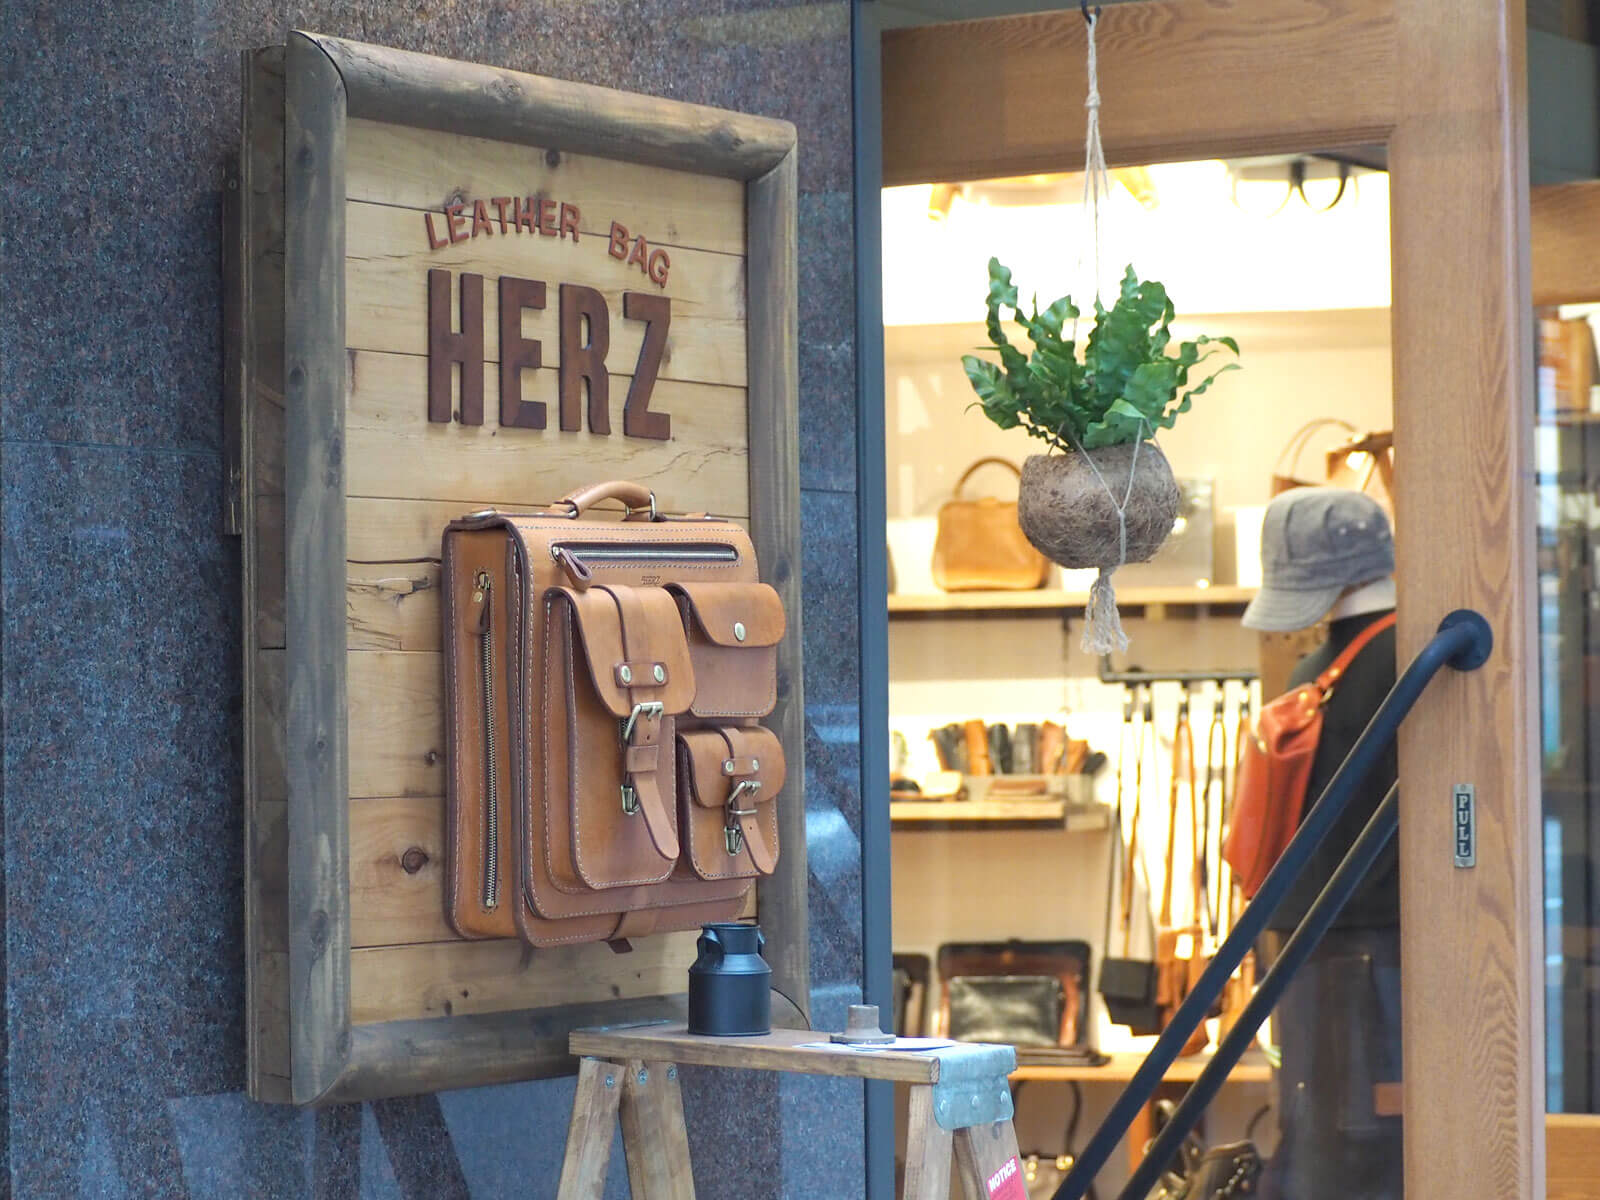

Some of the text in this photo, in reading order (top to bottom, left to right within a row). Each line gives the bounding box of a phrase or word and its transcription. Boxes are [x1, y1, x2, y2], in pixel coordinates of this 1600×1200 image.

[424, 196, 671, 288] LEATHER BAG
[428, 268, 671, 440] HERZ
[1457, 794, 1470, 857] PULL
[988, 1158, 1017, 1192] NOTICE
